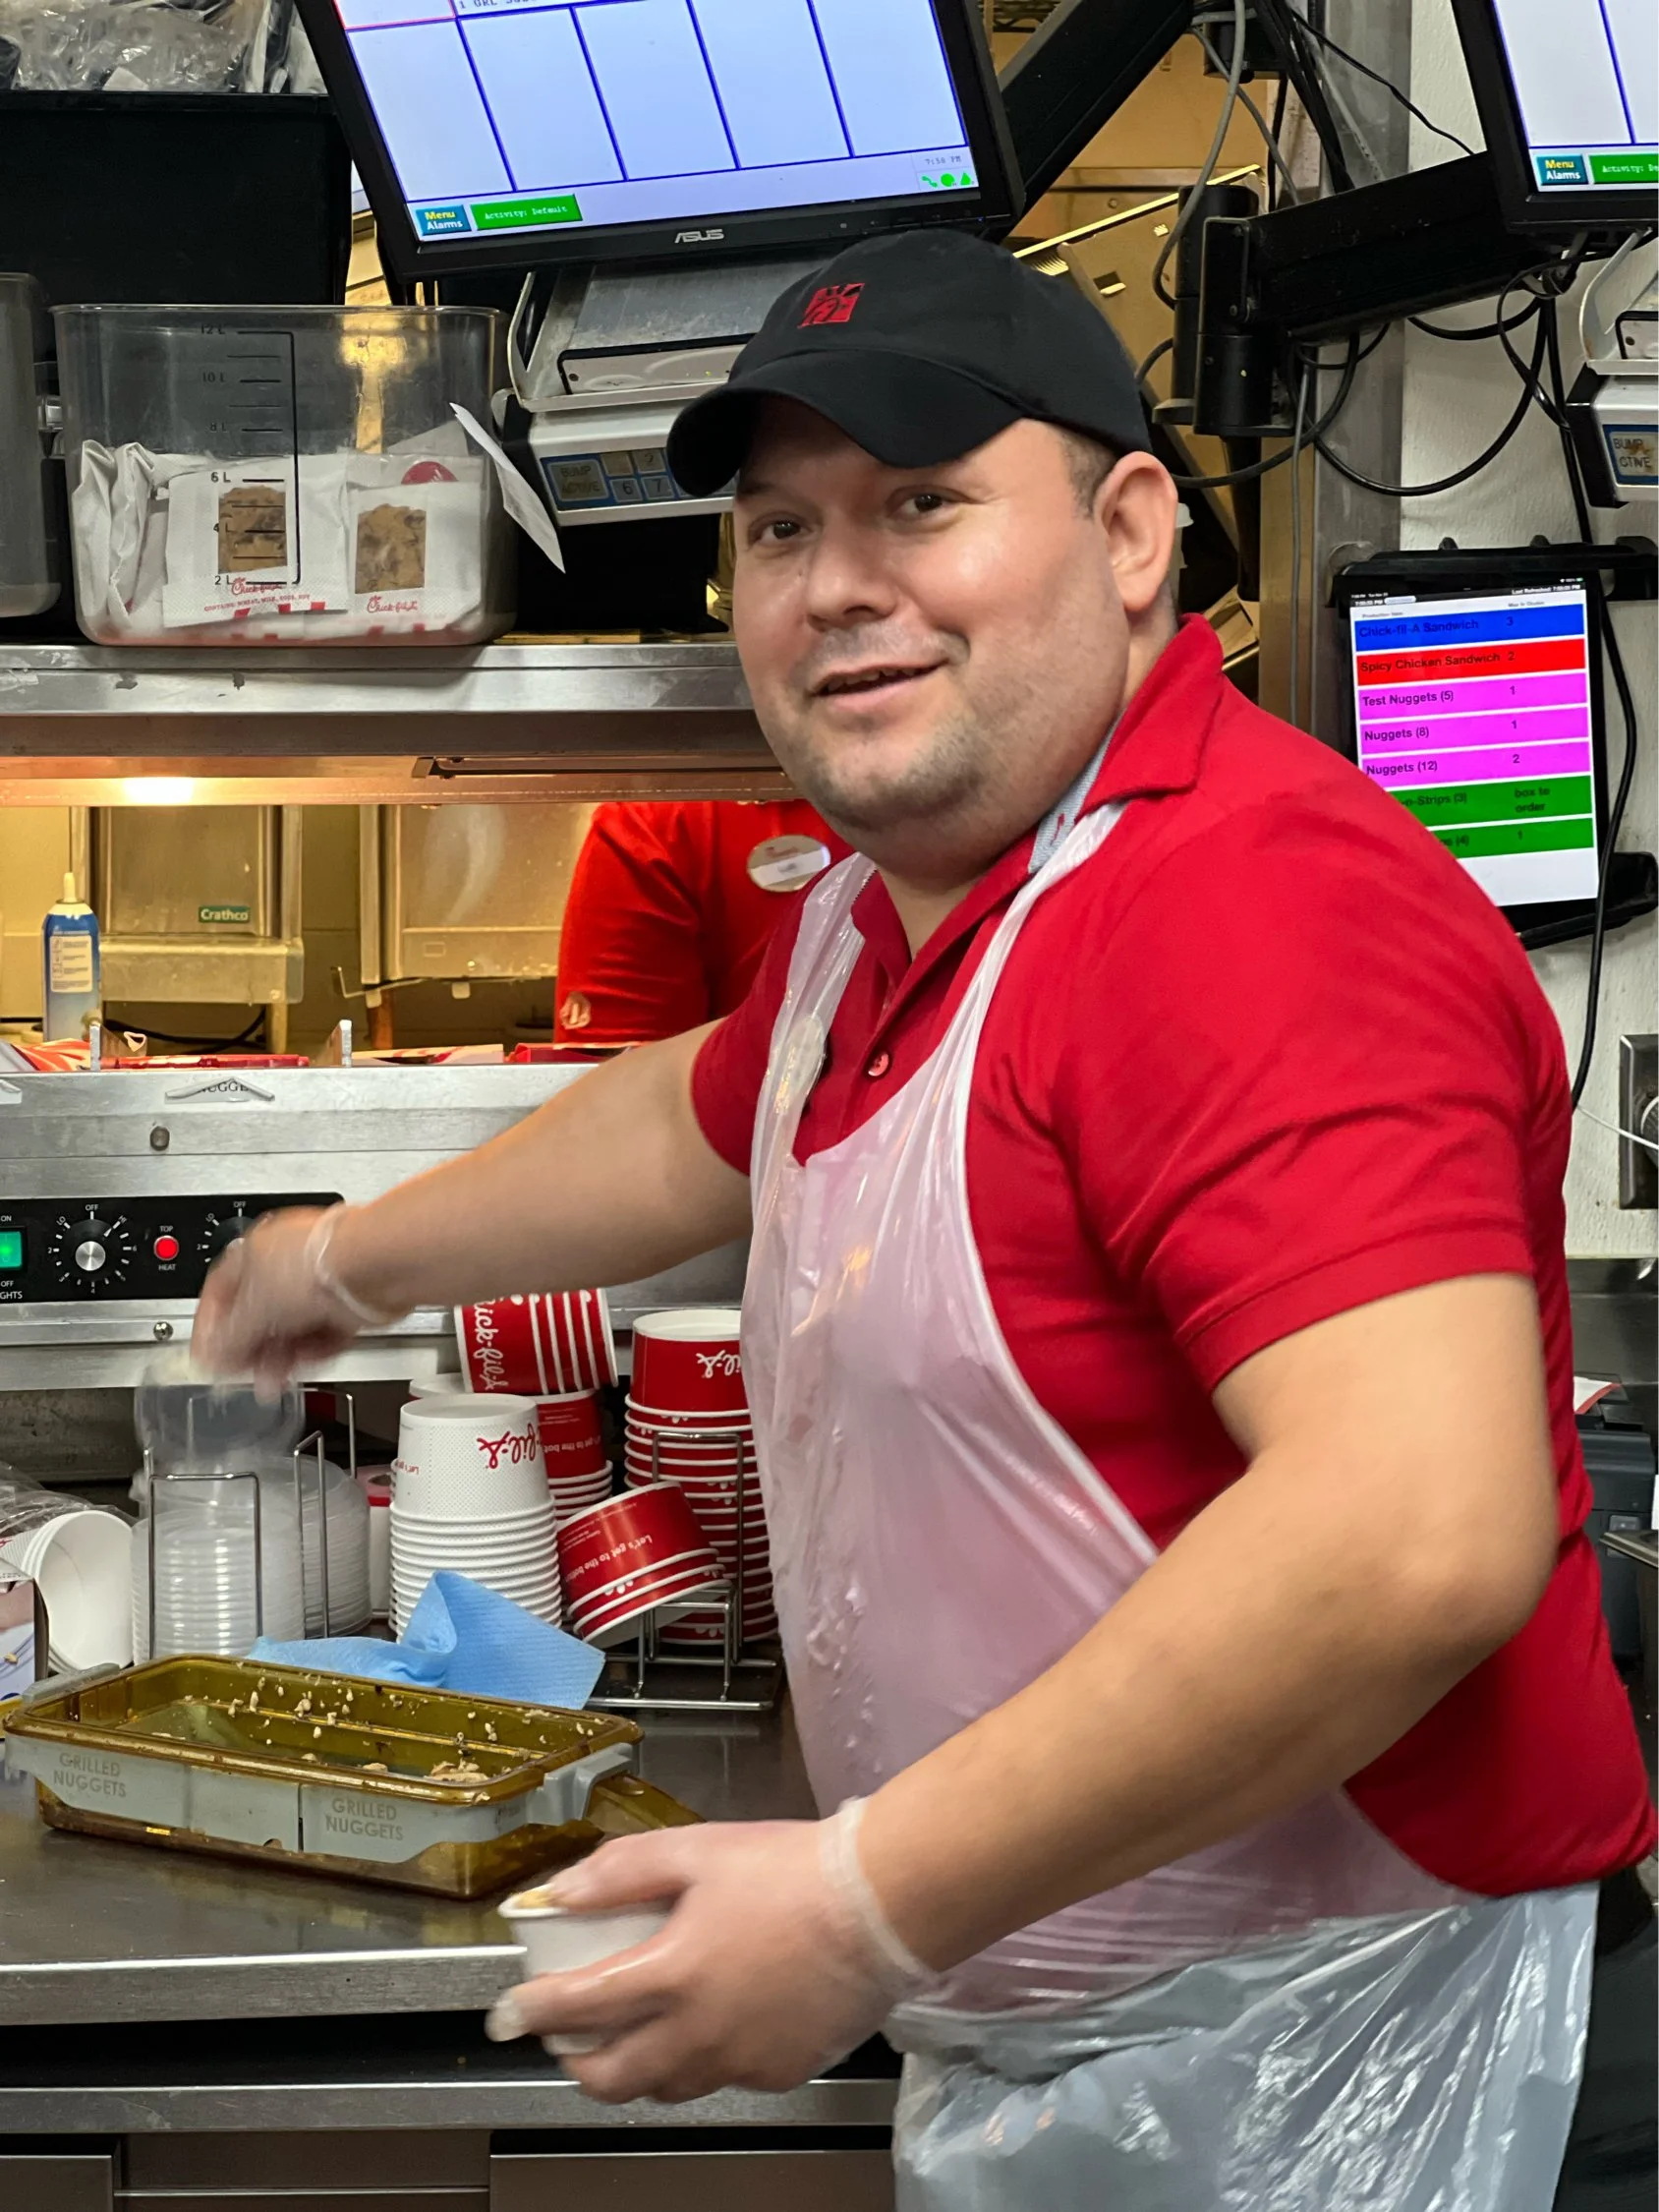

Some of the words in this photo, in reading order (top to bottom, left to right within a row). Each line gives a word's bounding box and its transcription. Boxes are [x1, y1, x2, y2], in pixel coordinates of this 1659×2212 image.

[1545, 160, 1574, 169] Menu
[1546, 170, 1580, 180] Alarms
[425, 210, 456, 220] Menu
[485, 209, 528, 220] Activity:
[533, 206, 568, 215] Default
[427, 218, 463, 231] Alarms
[675, 229, 724, 244] ASUS
[202, 372, 215, 382] 10
[220, 372, 226, 382] L
[210, 472, 219, 483] 6
[223, 472, 231, 483] L
[623, 480, 632, 495] 6
[653, 478, 661, 492] 7
[214, 575, 221, 586] 2
[226, 574, 234, 585] L
[1358, 623, 1420, 637] Chick-fil-A
[1423, 620, 1479, 632] Sandwich
[1506, 615, 1514, 626] 3
[1361, 662, 1392, 672] Spicy
[1396, 657, 1442, 669] Chicken
[1445, 653, 1501, 666] Sandwich
[1508, 651, 1515, 661] 2
[1362, 696, 1386, 706] Test
[1390, 692, 1437, 706] Nuggets
[1441, 690, 1454, 703] (5)
[1510, 686, 1516, 695] 1
[1364, 728, 1412, 741] Nuggets
[1415, 727, 1429, 738] (8)
[1512, 720, 1517, 729] 1
[1366, 763, 1414, 777] Nuggets
[1417, 761, 1438, 773] (12)
[1513, 754, 1519, 764] 2
[1516, 787, 1535, 798] box
[1539, 786, 1550, 796] to
[1516, 802, 1545, 813] order
[200, 908, 249, 921] Crathco
[57, 1216, 67, 1225] LO
[205, 1213, 215, 1222] LO
[627, 1534, 653, 1549] Let's
[600, 1552, 610, 1561] to
[584, 1558, 599, 1569] the
[59, 1752, 121, 1777] GRILLED
[53, 1770, 126, 1797] NUGGETS
[332, 1797, 397, 1821] GRILLED
[325, 1814, 404, 1841] NUGGETS
